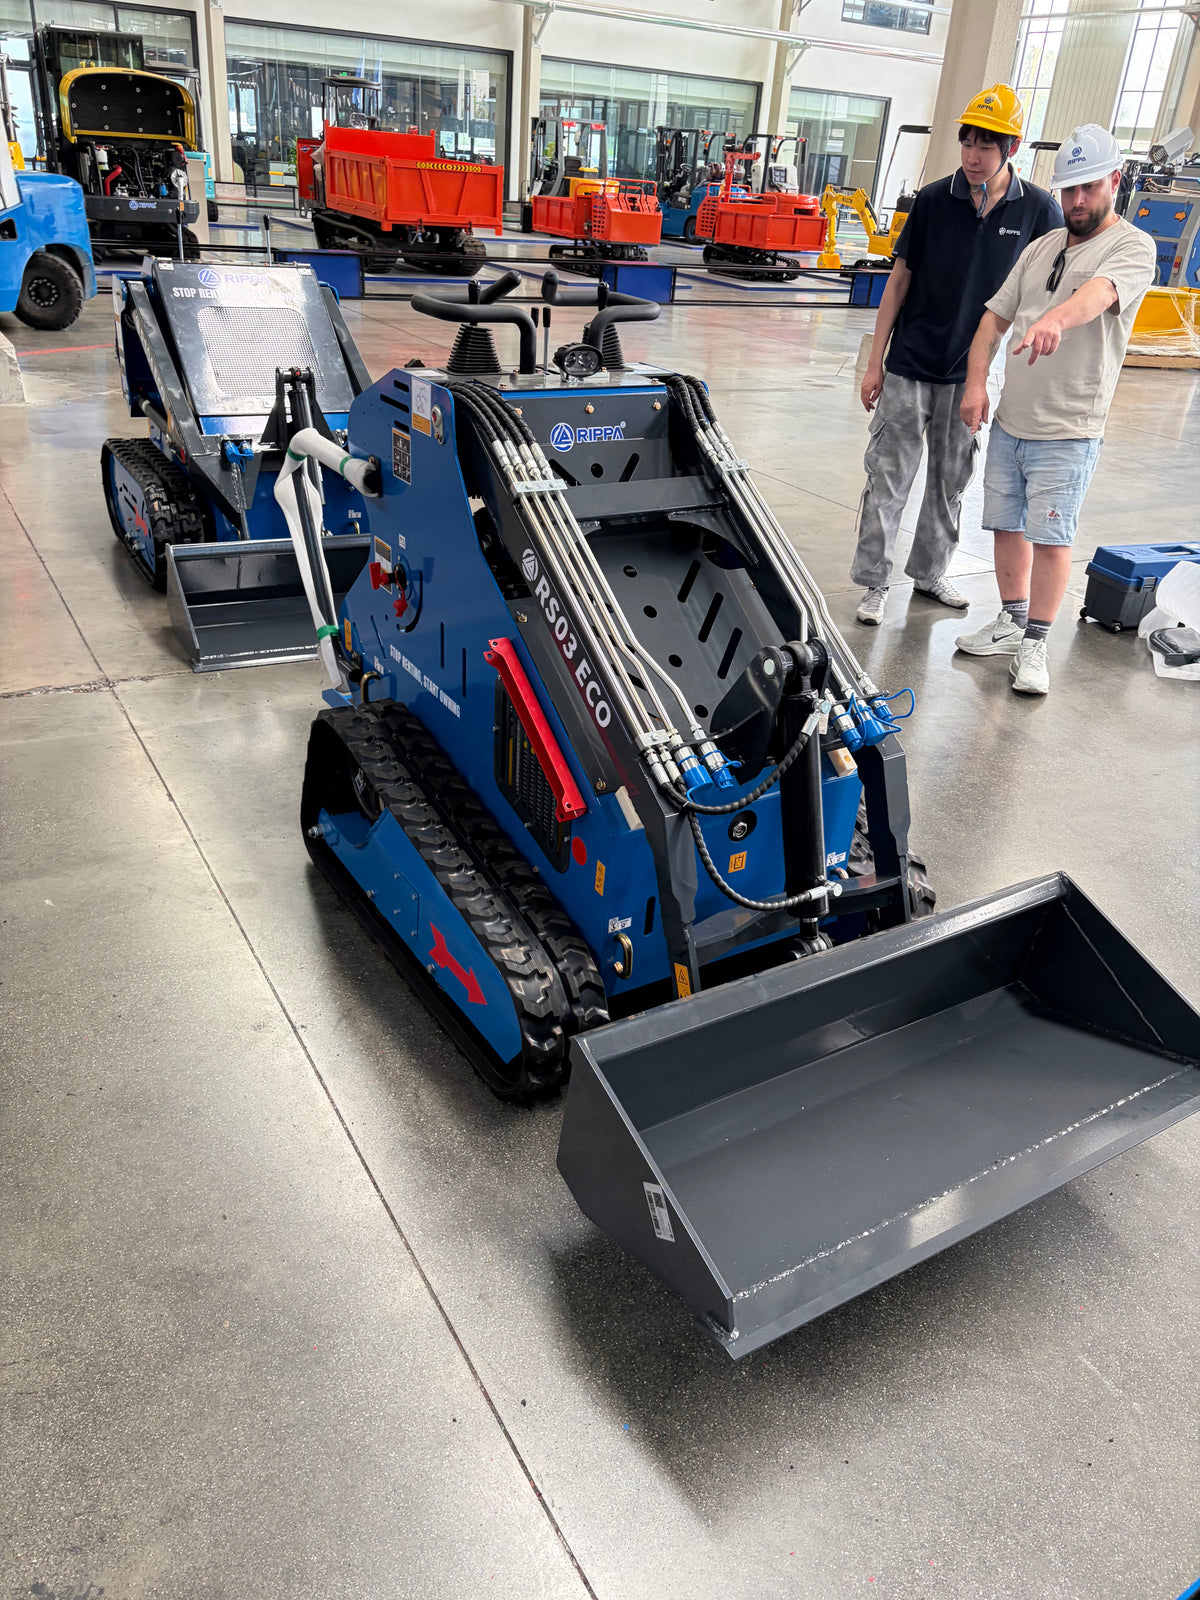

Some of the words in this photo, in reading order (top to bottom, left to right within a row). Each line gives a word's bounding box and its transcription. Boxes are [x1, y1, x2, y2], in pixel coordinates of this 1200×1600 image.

[977, 104, 993, 112] RIPPA
[1067, 157, 1086, 166] RIPPA
[224, 274, 270, 285] RIPPA
[172, 287, 197, 298] STOP
[534, 575, 578, 660] RS03
[574, 657, 611, 728] ECO
[389, 644, 402, 664] STOP
[423, 675, 439, 699] START
[439, 689, 461, 719] OWNING
